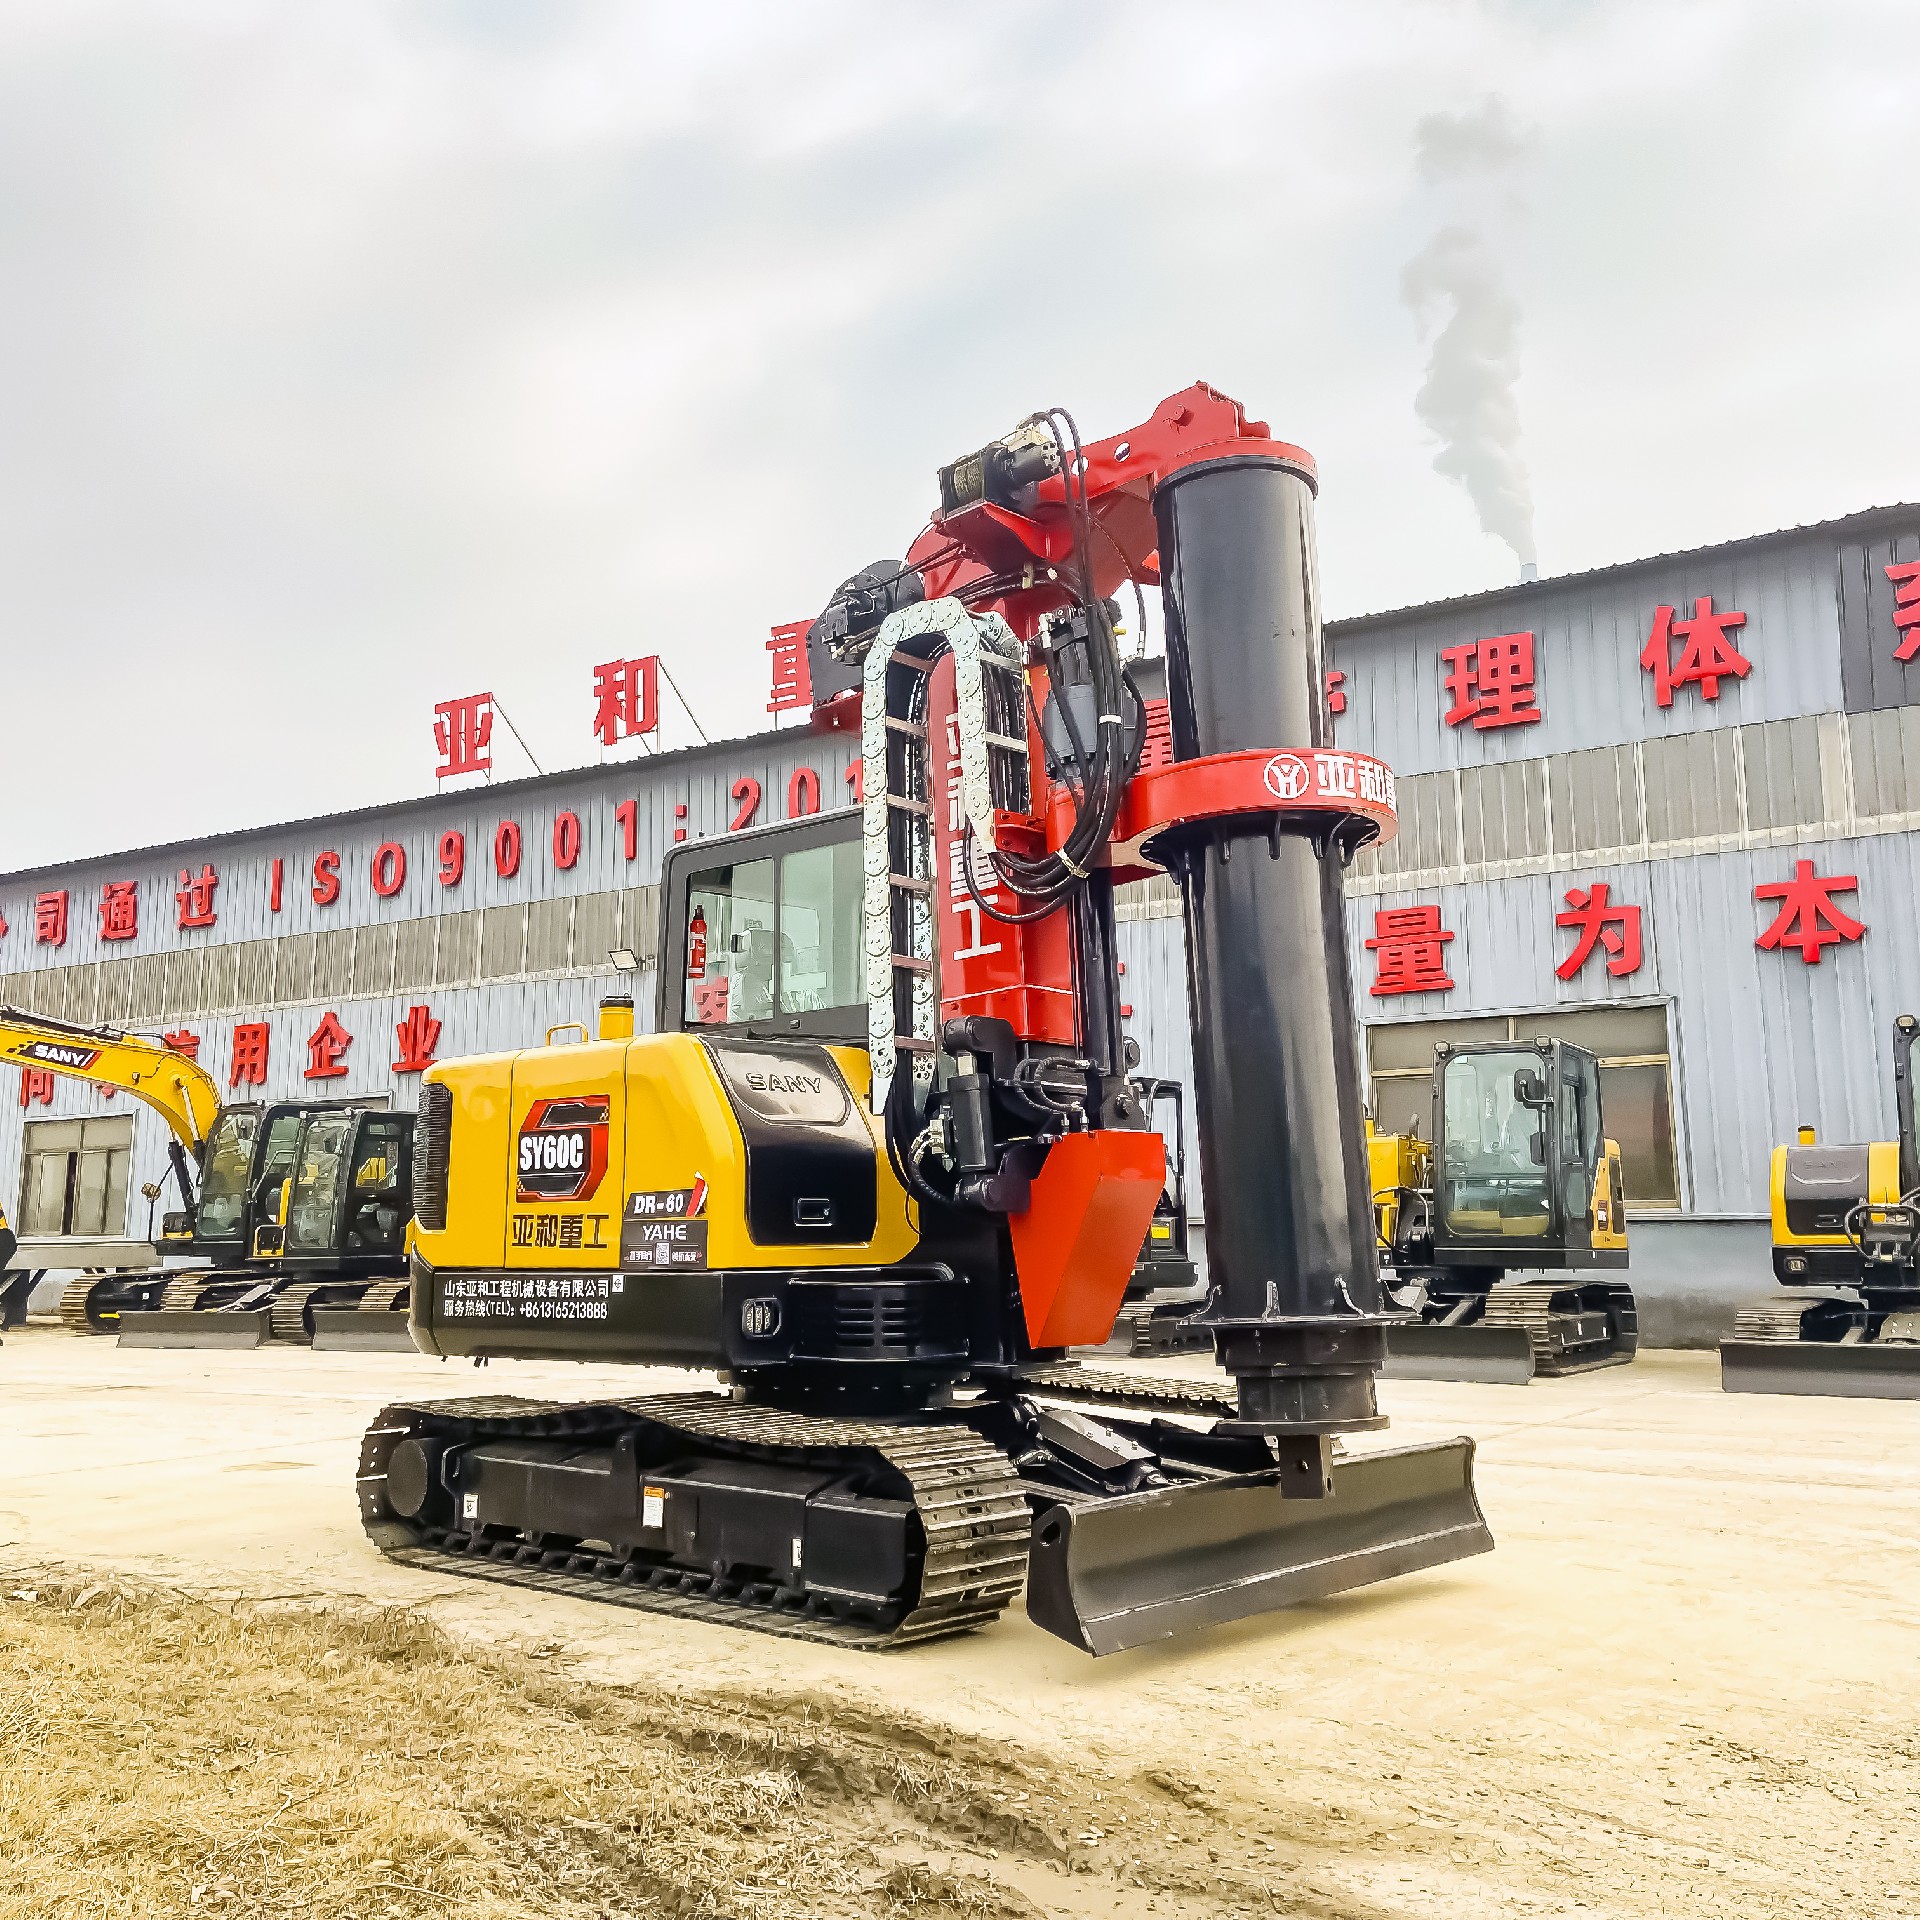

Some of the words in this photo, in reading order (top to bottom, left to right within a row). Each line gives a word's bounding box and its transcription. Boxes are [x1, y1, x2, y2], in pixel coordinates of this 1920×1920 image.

[1365, 860, 1866, 996] 量为本
[34, 1044, 84, 1066] SANY
[746, 1073, 820, 1094] SANY
[519, 1134, 584, 1170] SY60C
[634, 1193, 684, 1214] DR-60
[511, 1213, 610, 1249] 亚和重工
[642, 1224, 687, 1240] YAHE
[443, 1279, 609, 1298] 山东亚和工程机械设备有限公司
